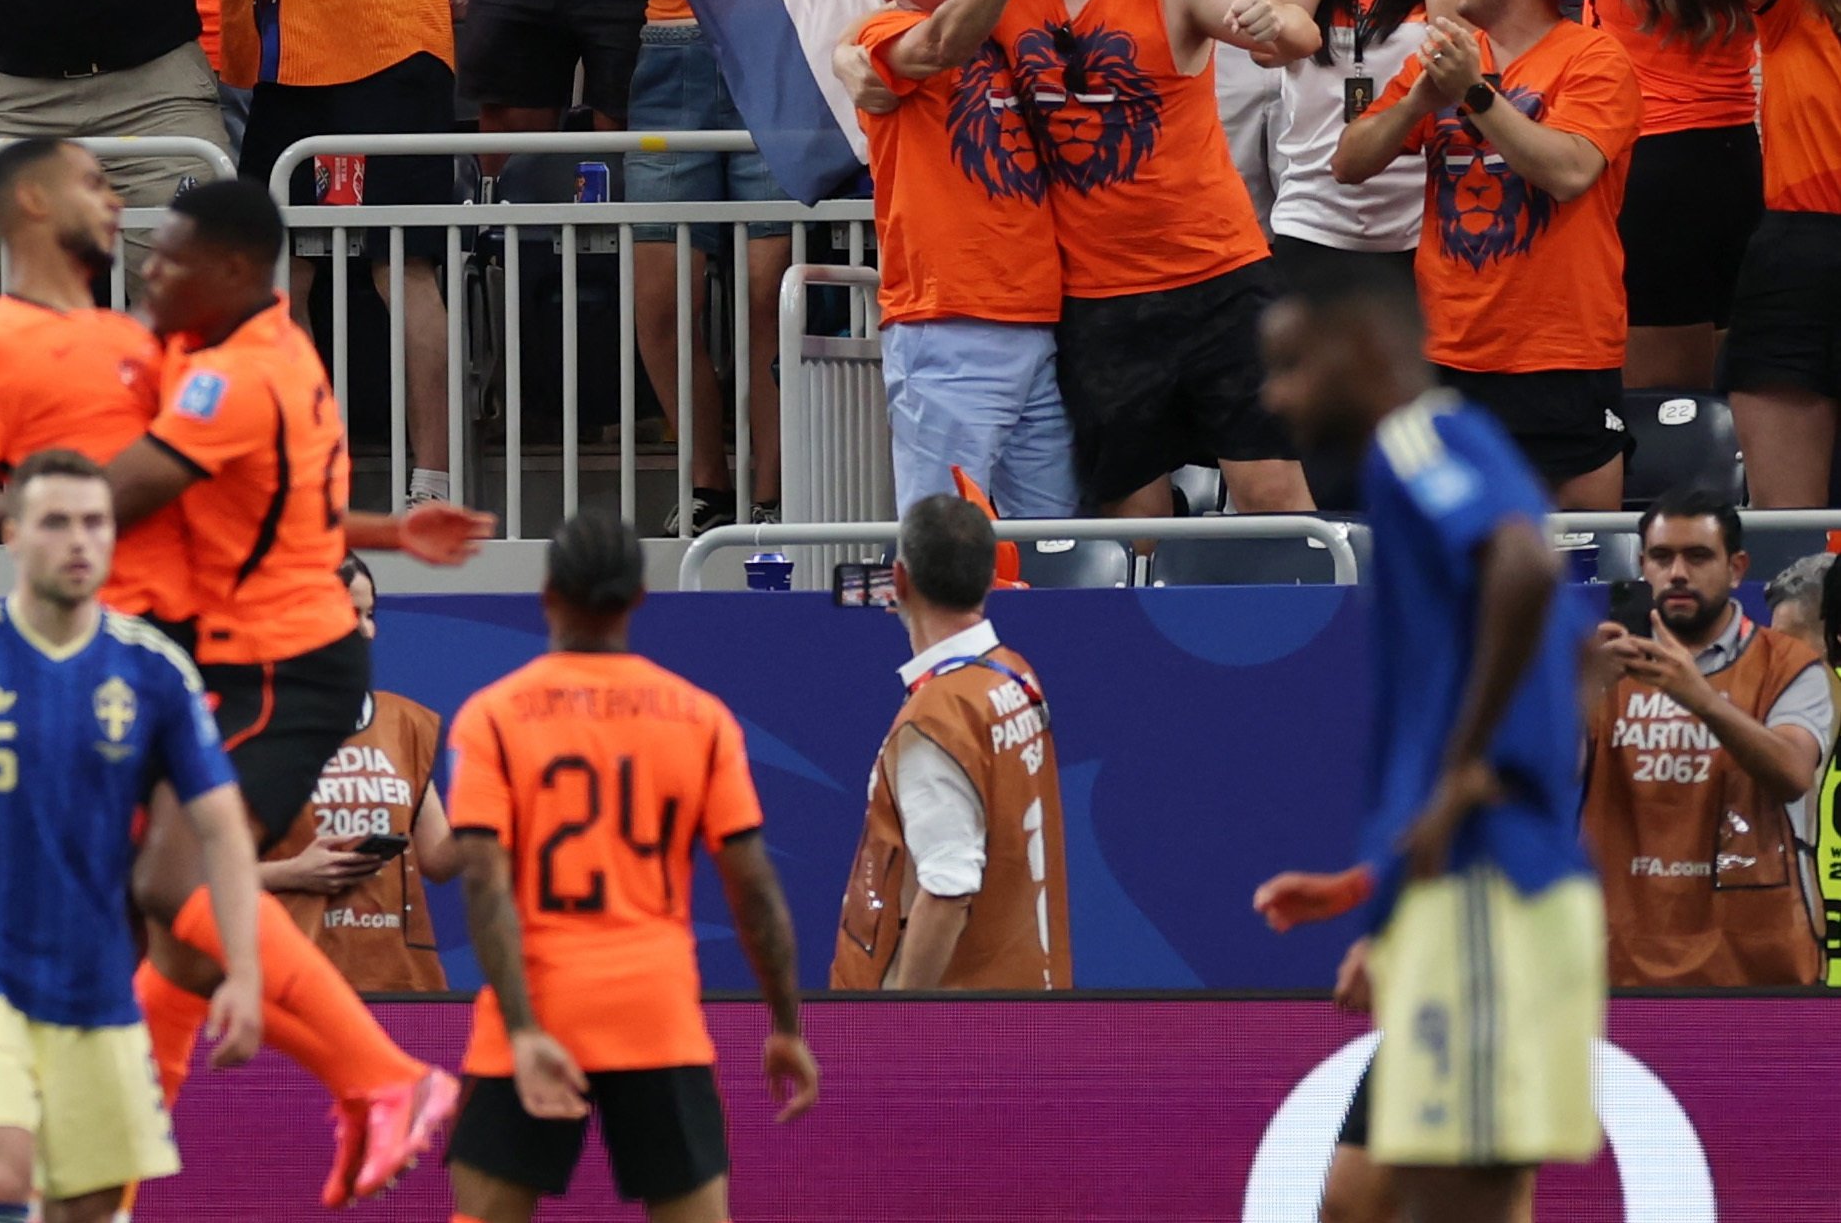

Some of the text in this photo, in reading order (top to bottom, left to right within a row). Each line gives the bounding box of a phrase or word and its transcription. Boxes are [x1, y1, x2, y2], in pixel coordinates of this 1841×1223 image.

[1665, 405, 1689, 419] 22
[322, 746, 396, 775] EDIA
[1633, 753, 1712, 783] 2062
[314, 807, 390, 837] 2068
[539, 753, 679, 914] 24
